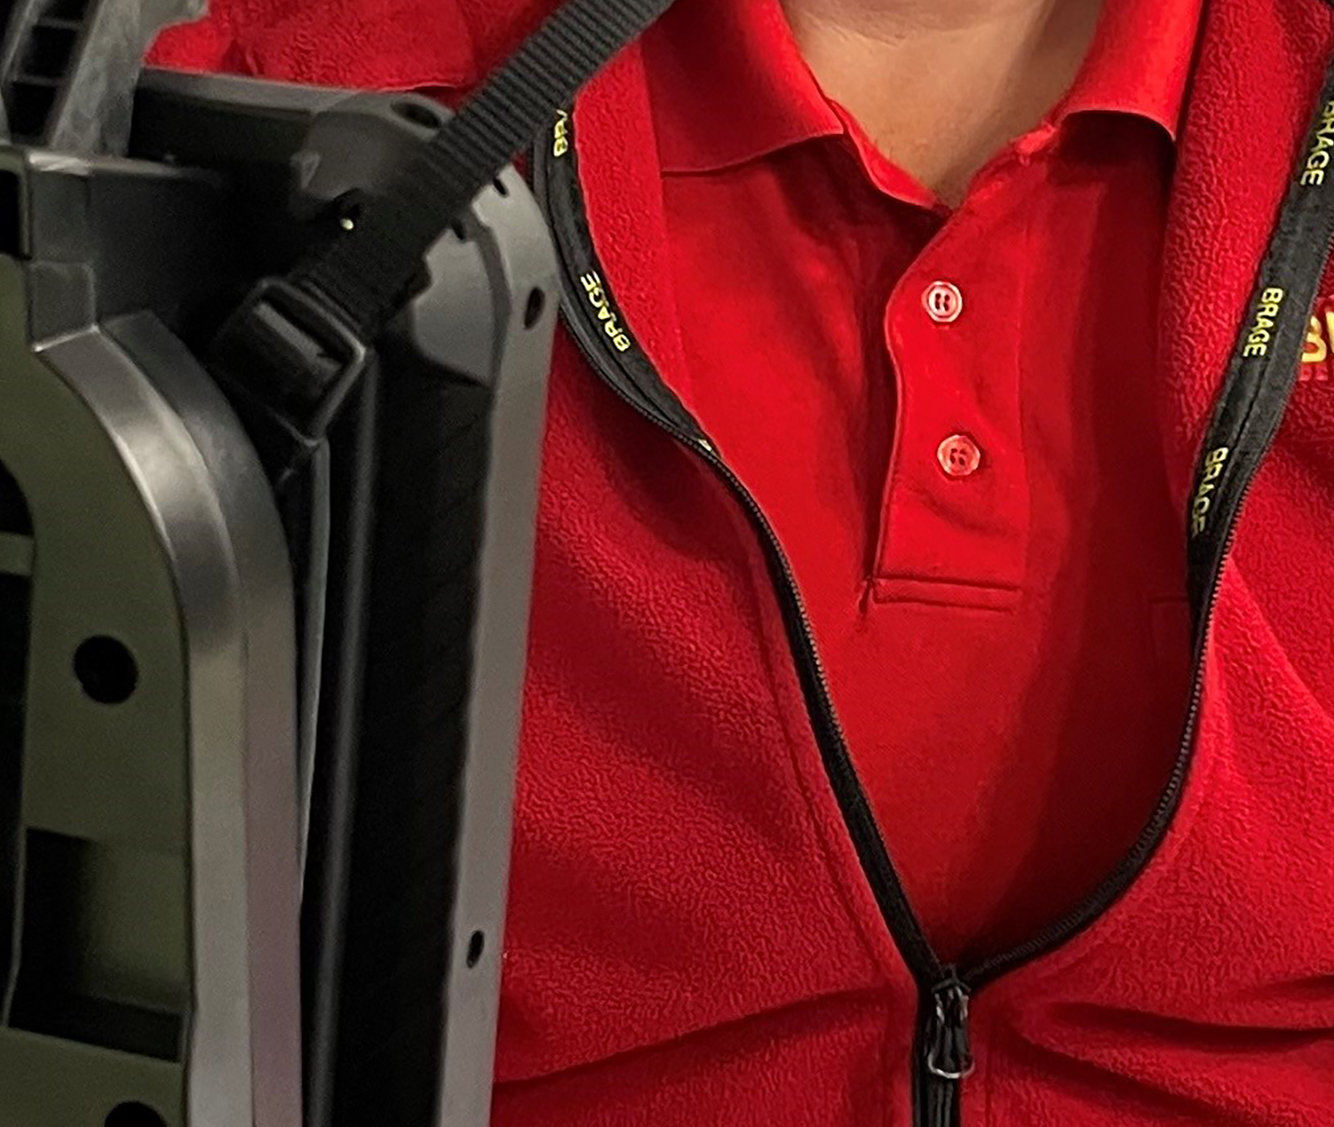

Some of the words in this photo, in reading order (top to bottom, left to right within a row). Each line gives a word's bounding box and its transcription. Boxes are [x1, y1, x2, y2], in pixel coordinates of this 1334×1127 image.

[580, 271, 631, 352] BRAGE
[1243, 287, 1284, 358] BRAGE
[1191, 447, 1229, 539] BRAGE
